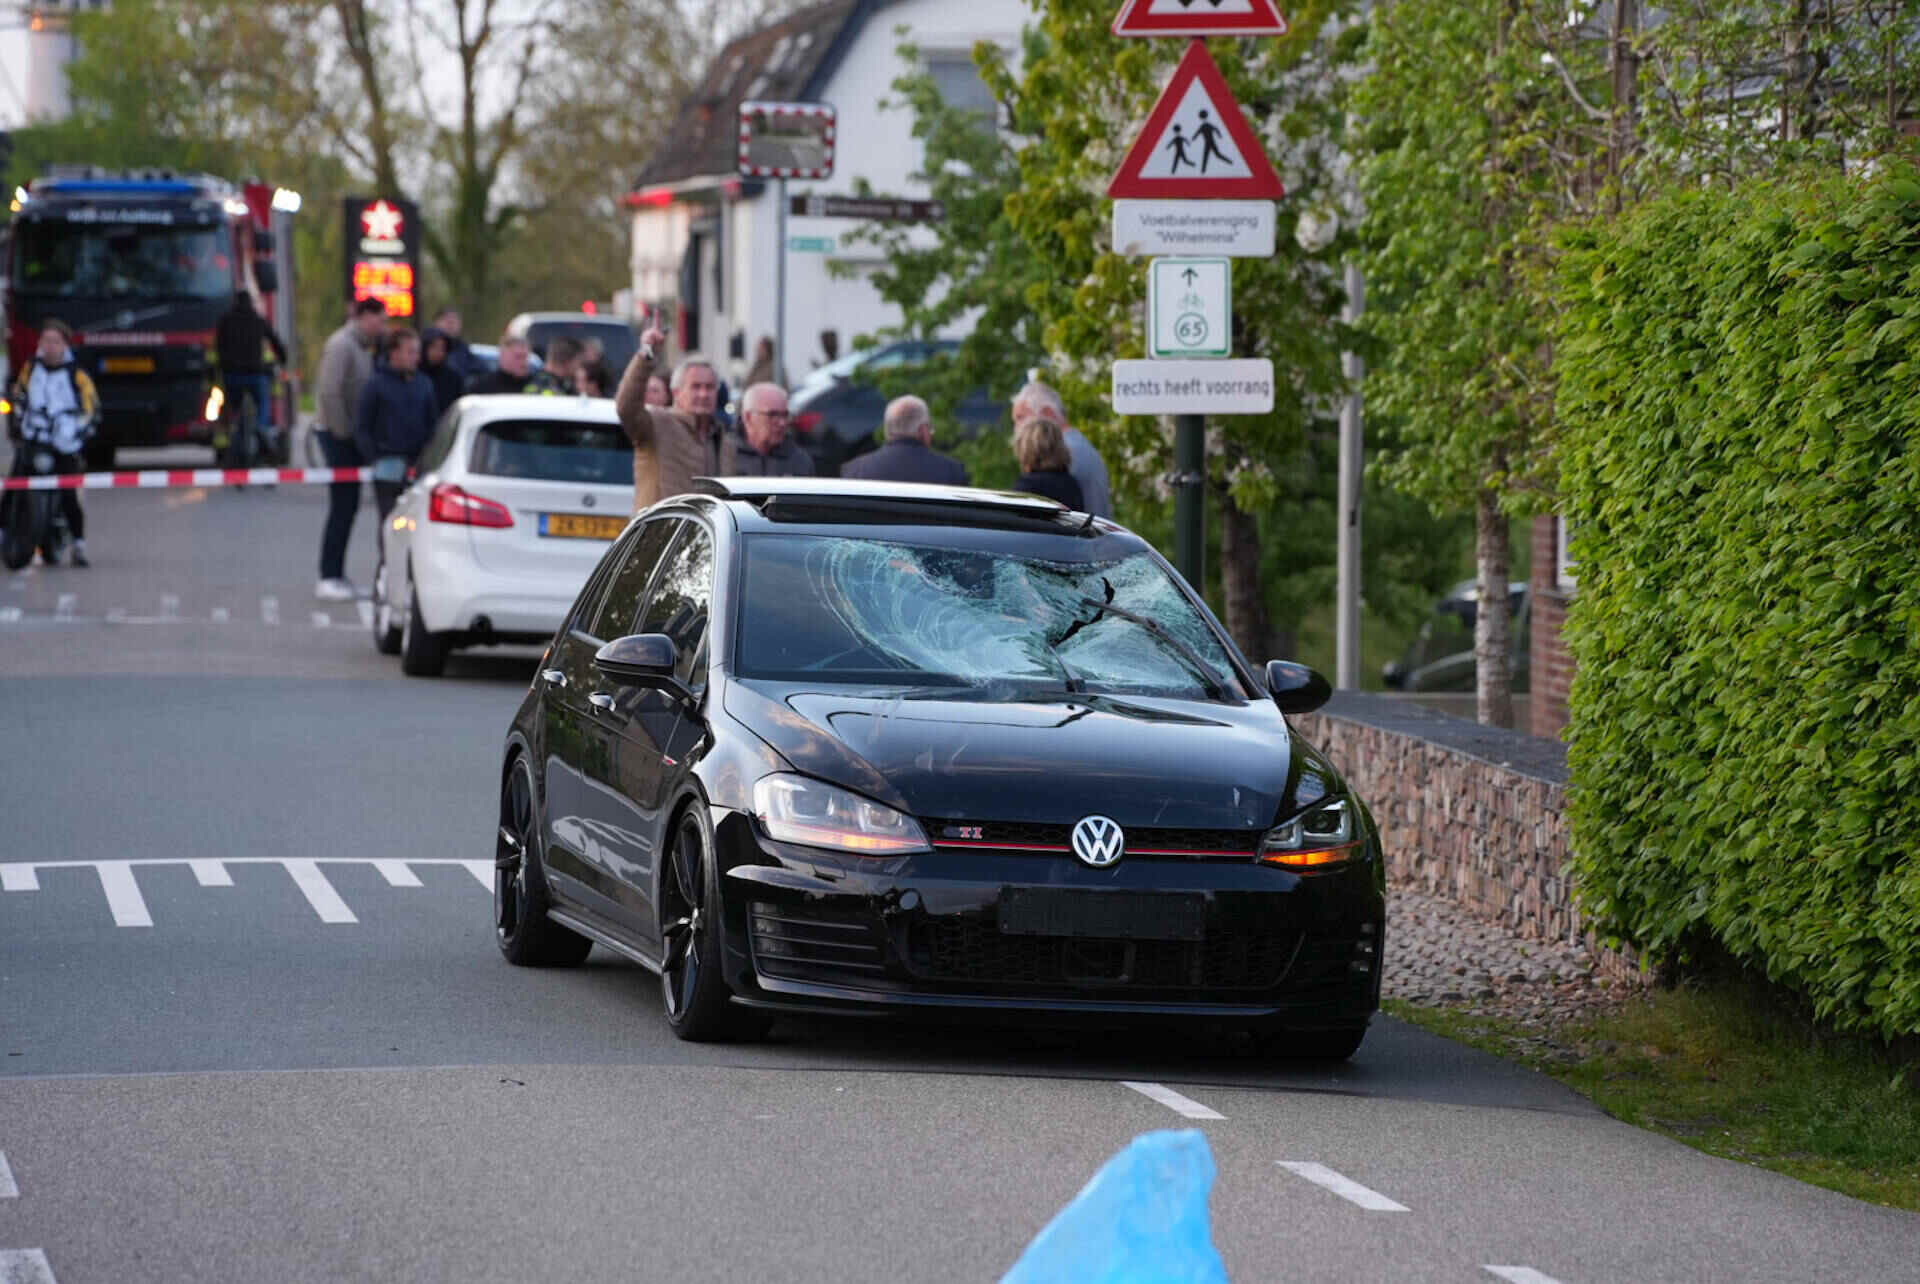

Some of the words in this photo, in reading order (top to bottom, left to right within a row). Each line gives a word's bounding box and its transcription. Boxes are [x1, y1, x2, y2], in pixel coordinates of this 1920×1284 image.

[1139, 213, 1259, 229] Voetbalvereniging
[1179, 321, 1203, 337] 65
[1115, 379, 1161, 397] rechts
[1164, 378, 1201, 397] heeft
[1206, 379, 1270, 398] voorrang
